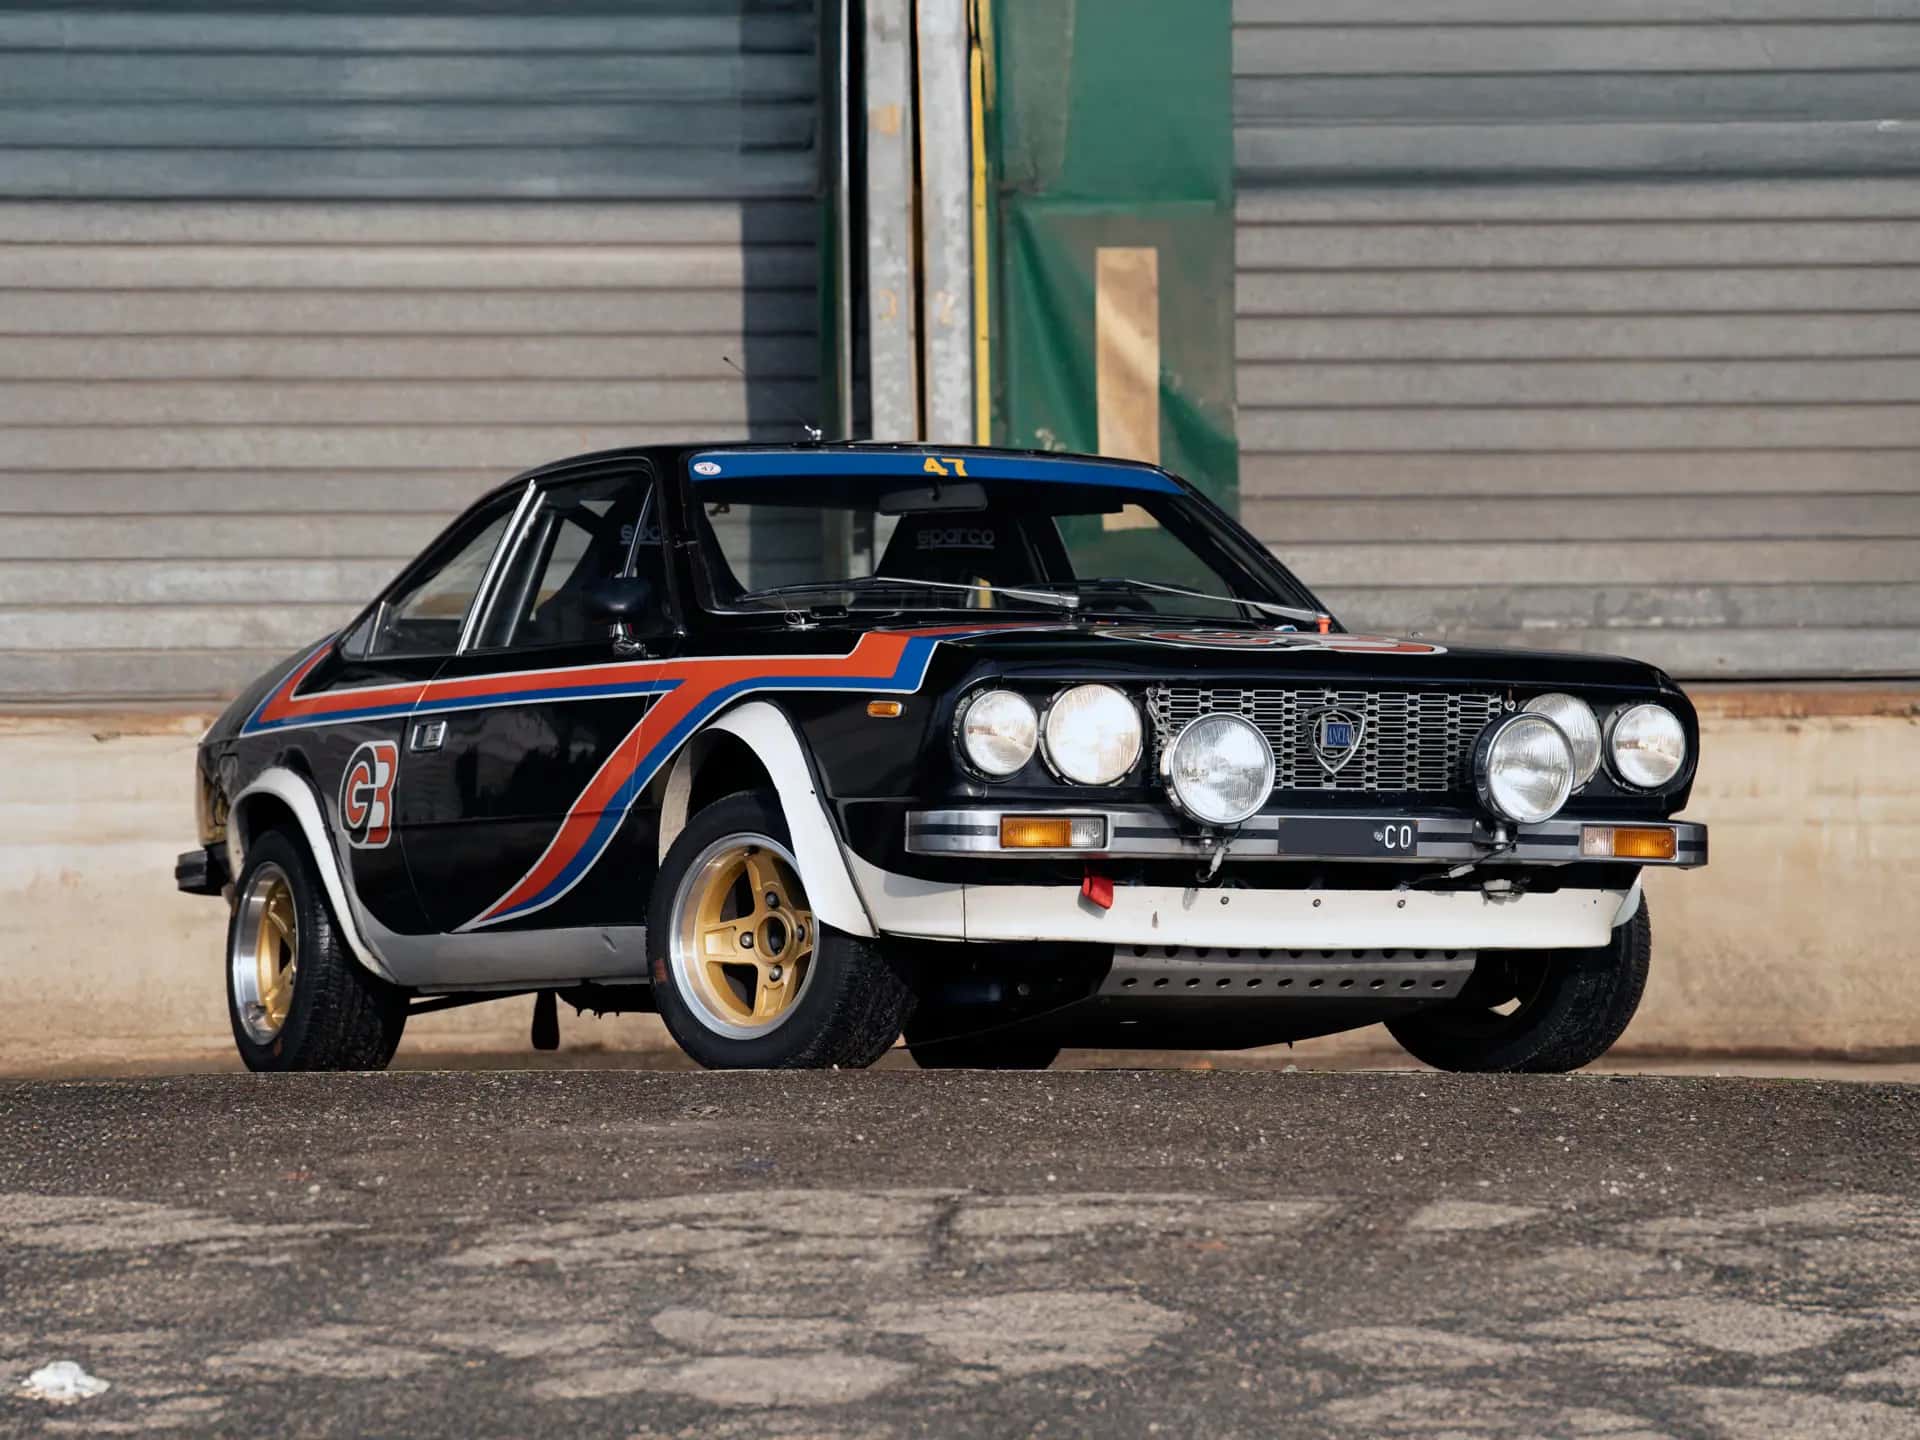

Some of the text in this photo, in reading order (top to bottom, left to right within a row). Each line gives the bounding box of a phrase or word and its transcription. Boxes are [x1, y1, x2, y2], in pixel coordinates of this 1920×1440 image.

[924, 457, 968, 477] 47
[917, 529, 994, 550] sparco
[1385, 825, 1411, 848] CO
